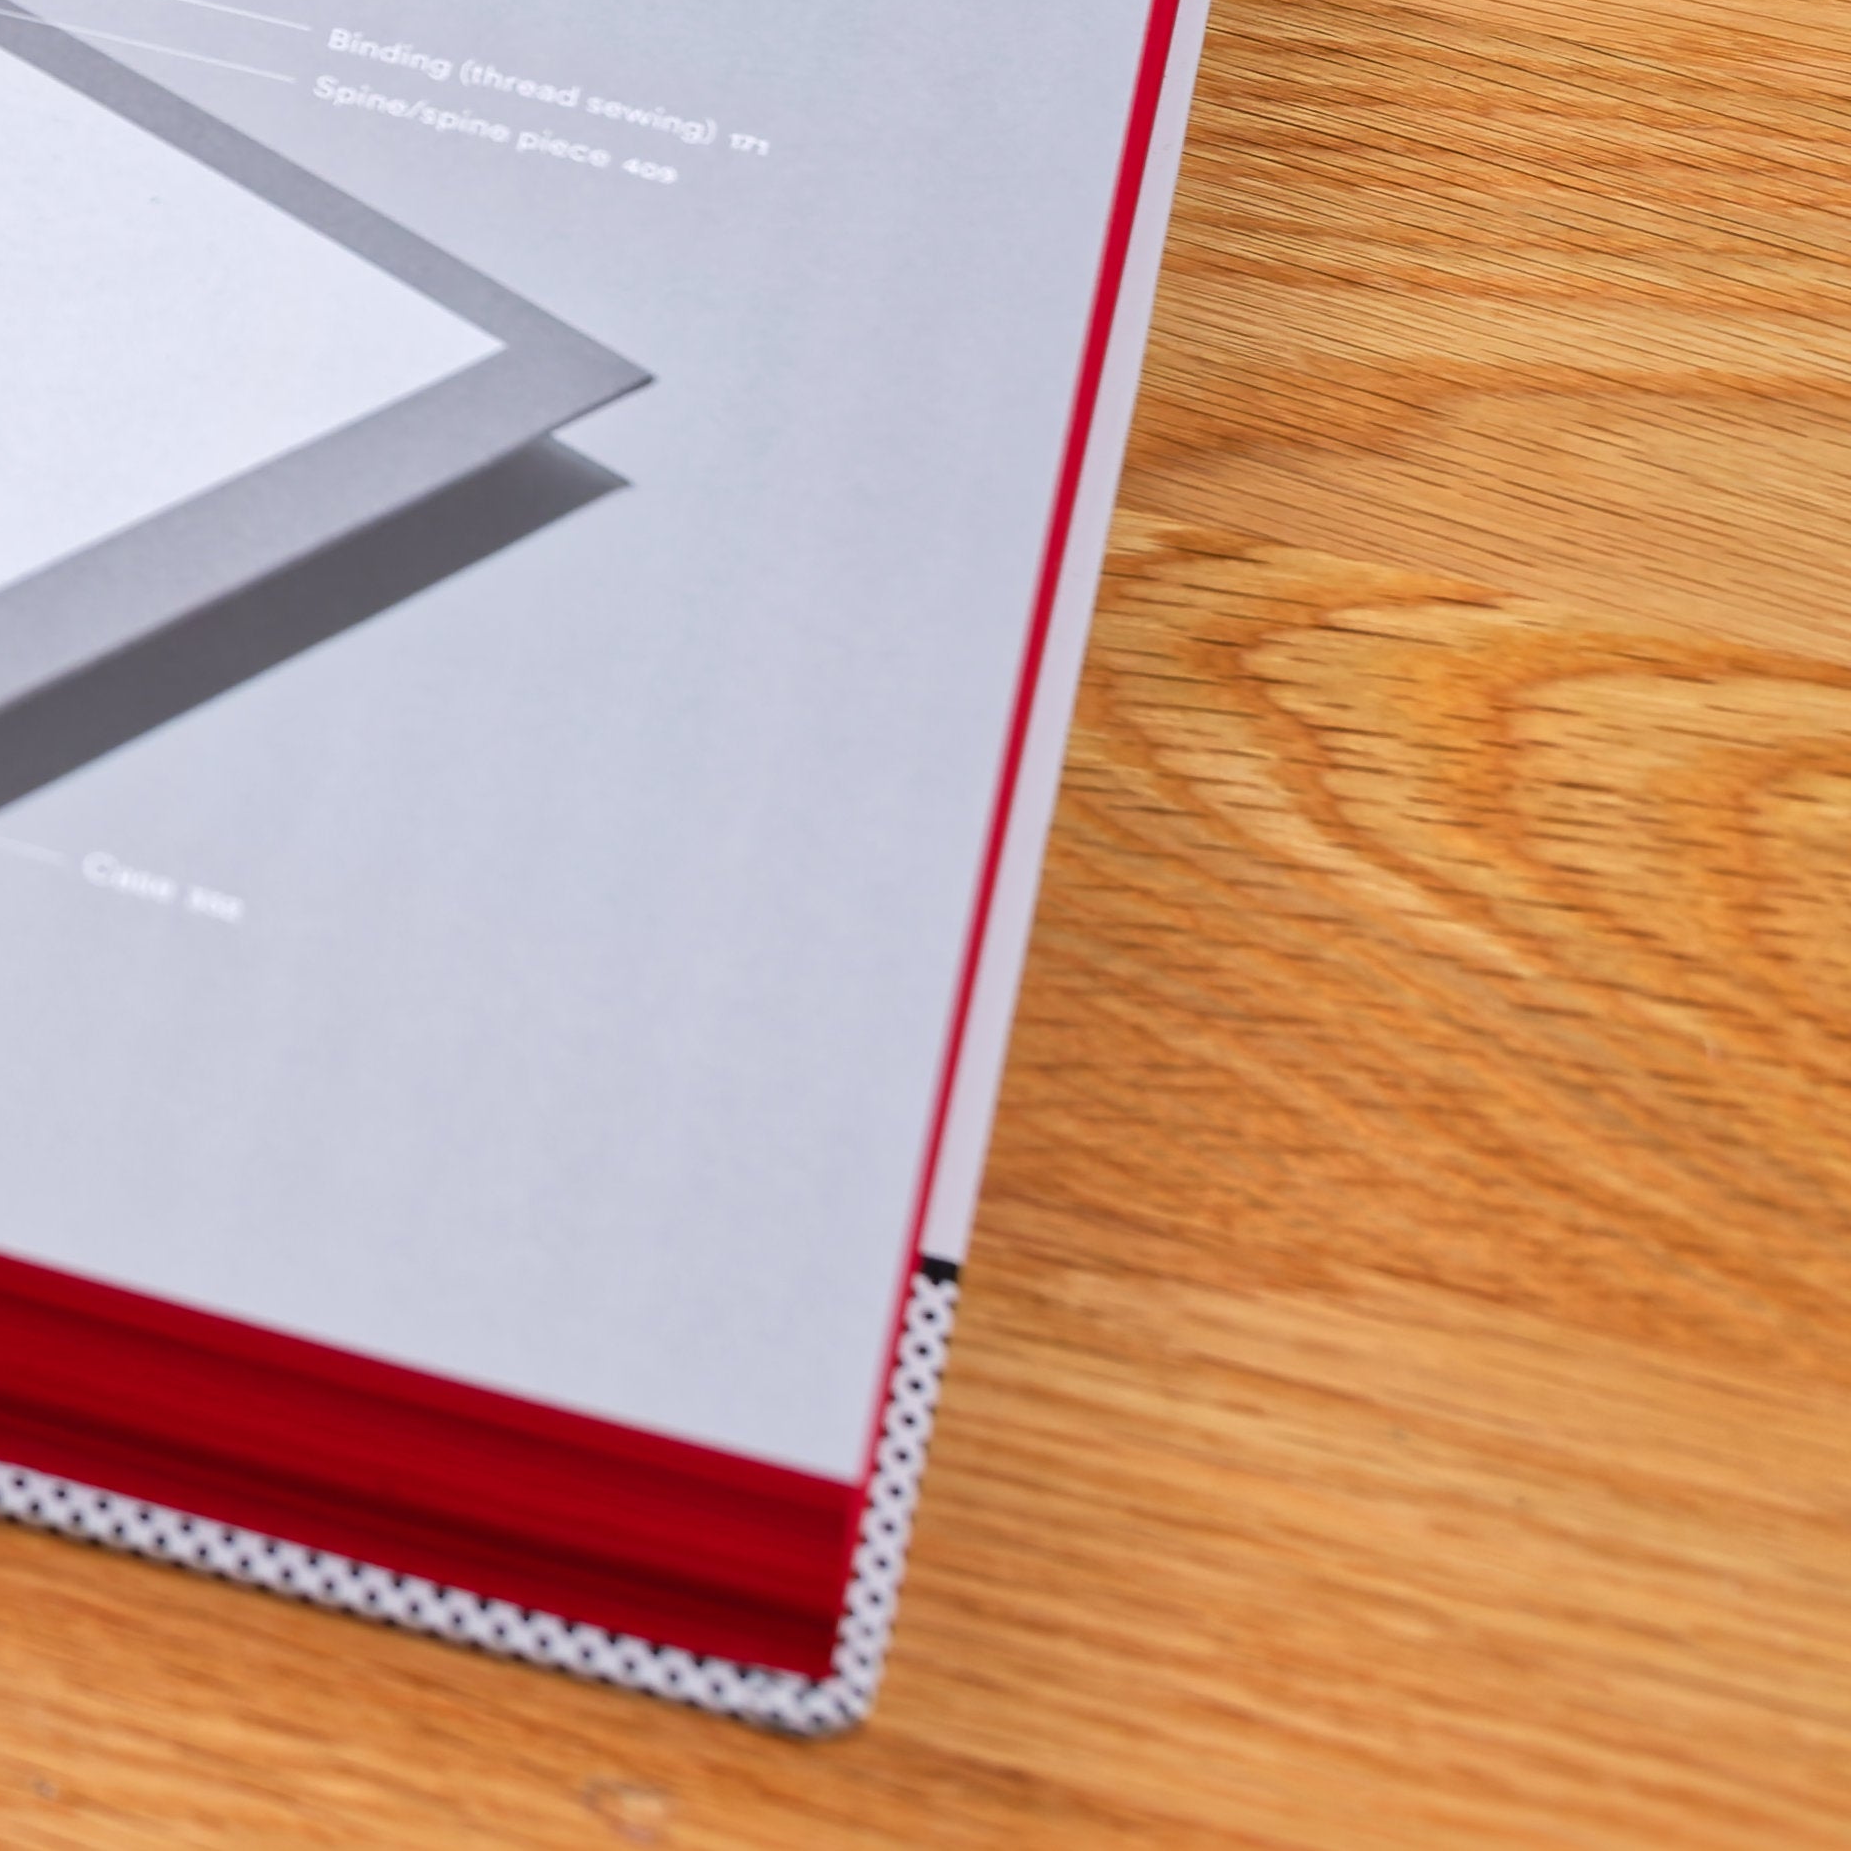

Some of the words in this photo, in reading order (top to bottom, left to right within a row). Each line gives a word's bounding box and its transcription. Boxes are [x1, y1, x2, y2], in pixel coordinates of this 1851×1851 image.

[312, 74, 512, 145] Spine/spine
[516, 127, 611, 169] piece
[326, 27, 453, 82] Binding
[459, 58, 581, 108] (thread
[585, 91, 718, 147] sewing)
